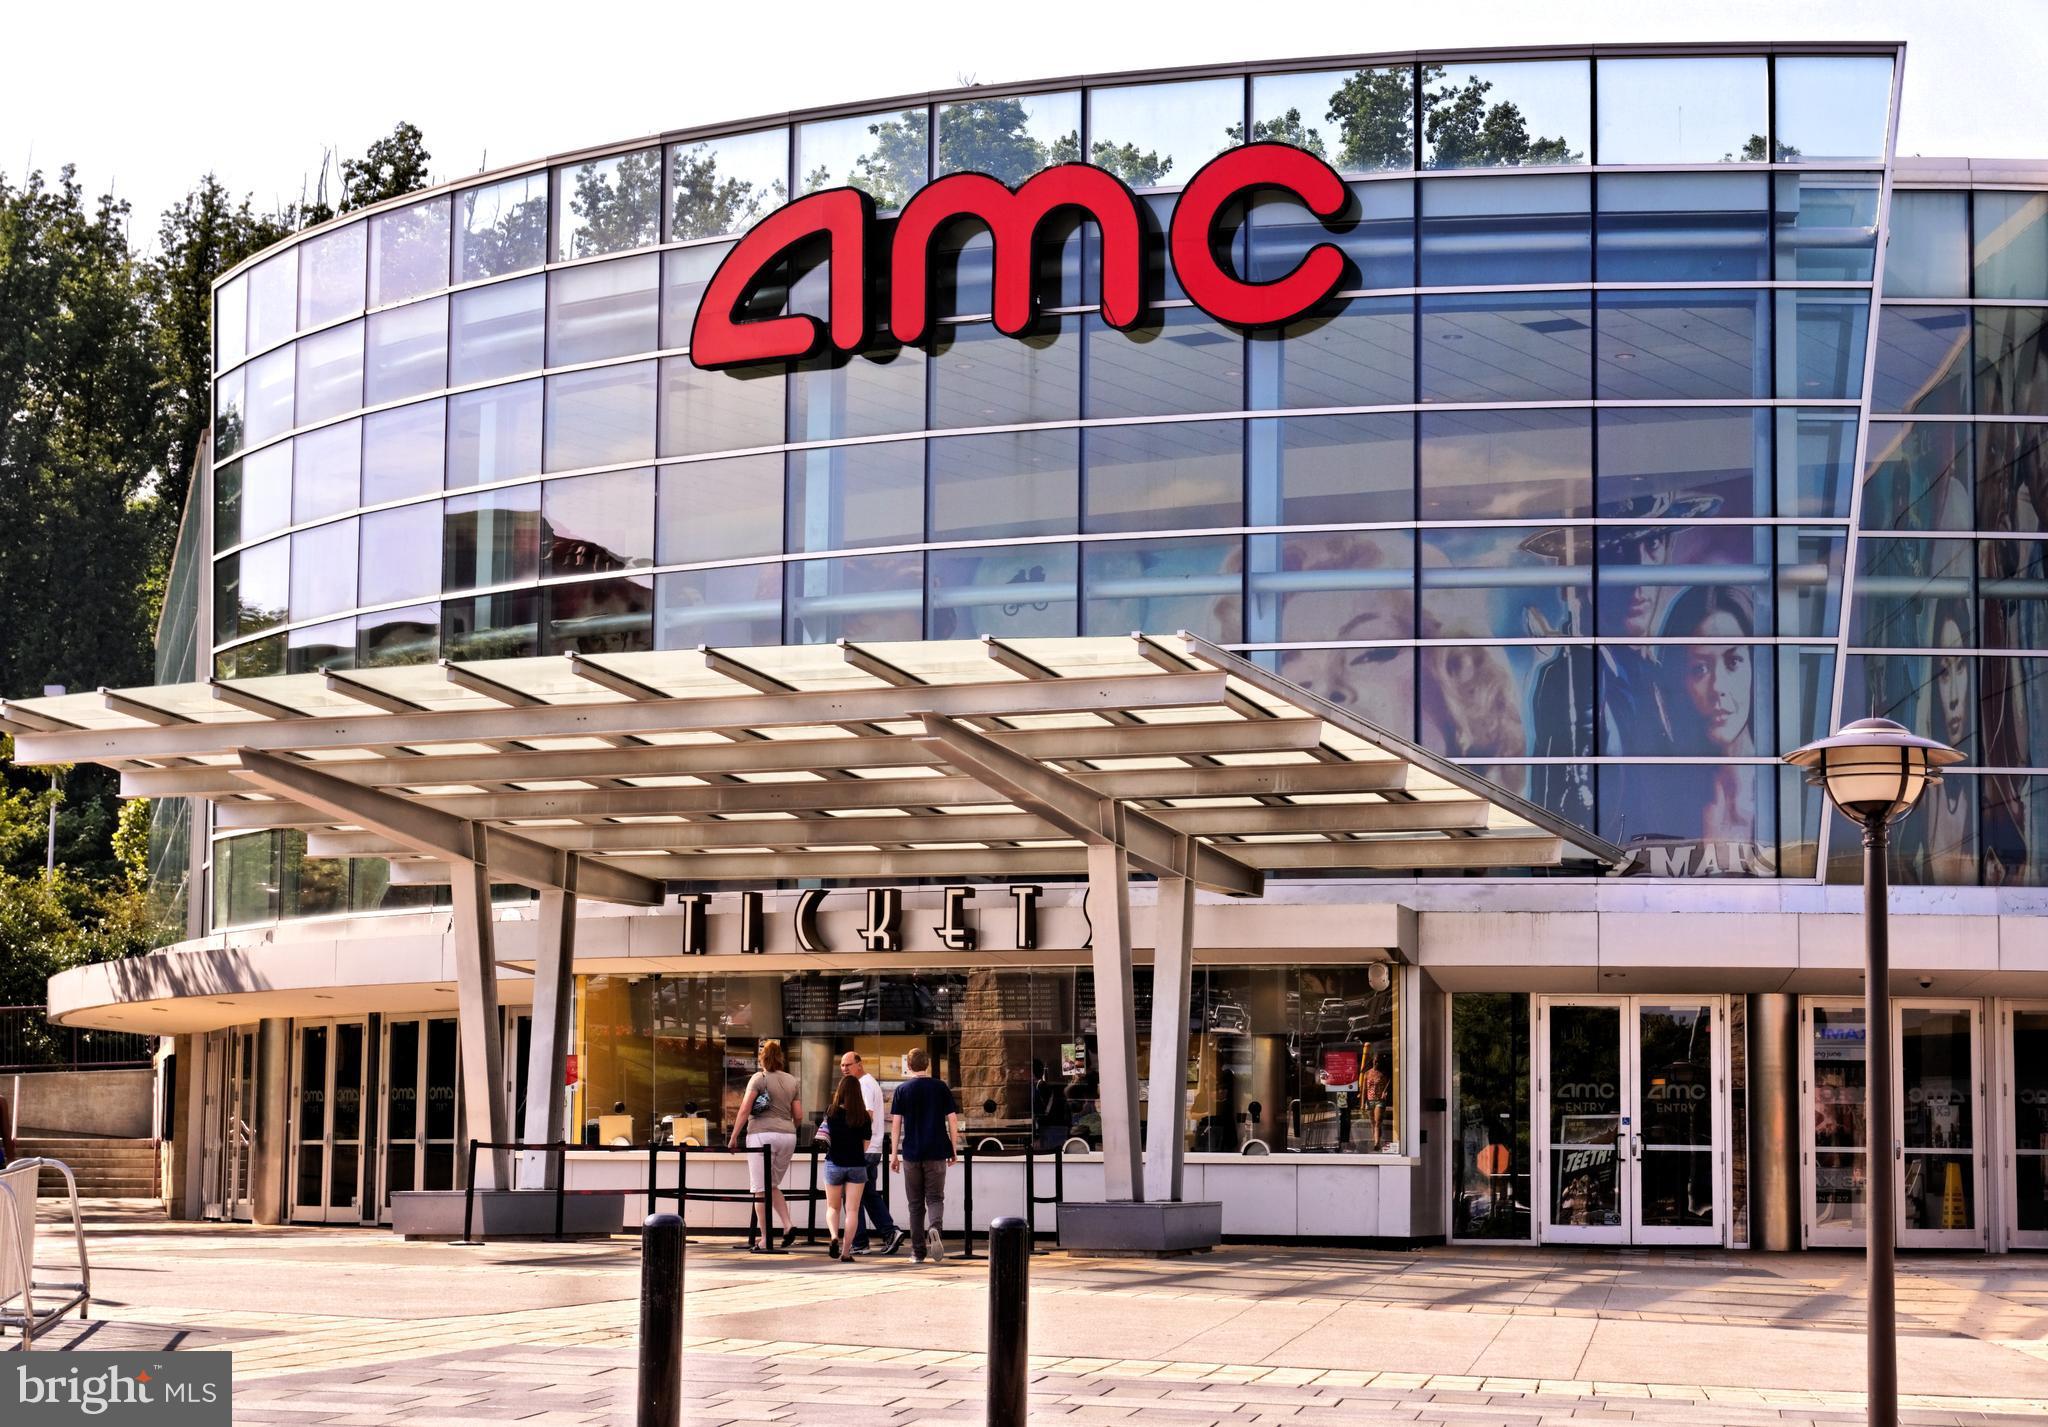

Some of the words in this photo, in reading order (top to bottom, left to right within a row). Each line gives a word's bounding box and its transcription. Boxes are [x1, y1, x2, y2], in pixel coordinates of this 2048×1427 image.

[690, 141, 1348, 371] amc
[677, 885, 1094, 955] TICKET
[1557, 1083, 1615, 1099] amc
[1648, 1084, 1706, 1100] amc
[1565, 1102, 1606, 1112] ENTRY
[1656, 1103, 1696, 1113] ENTRY
